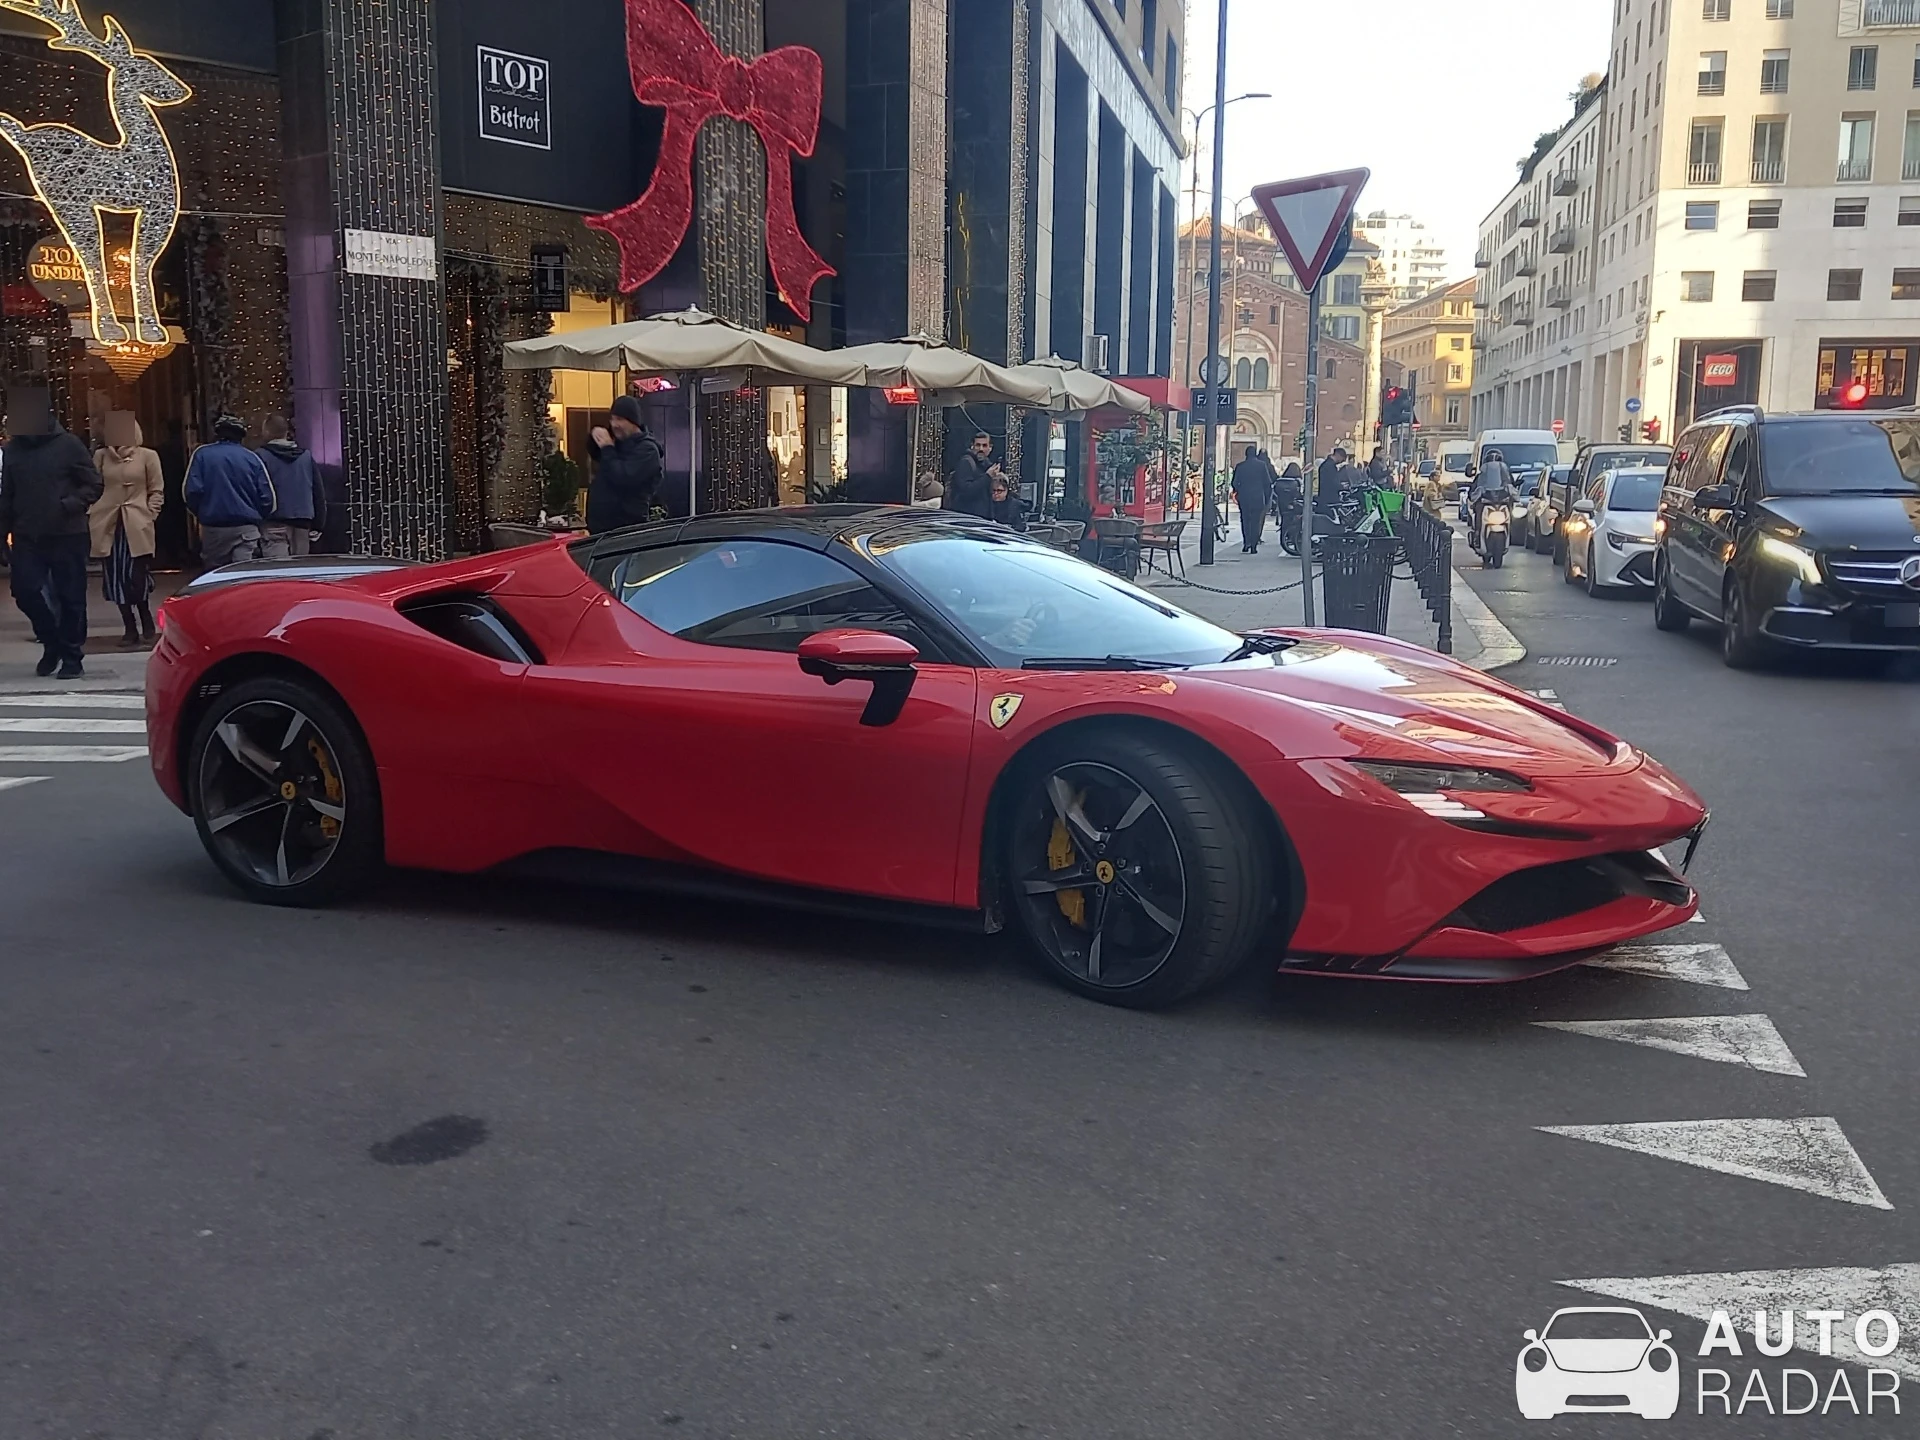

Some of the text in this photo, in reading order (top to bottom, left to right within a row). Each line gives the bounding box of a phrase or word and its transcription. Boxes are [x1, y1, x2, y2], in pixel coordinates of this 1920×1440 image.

[483, 54, 544, 93] TOP
[490, 104, 541, 133] Bistrot
[385, 237, 397, 245] VIA
[347, 251, 434, 268] MONTE NAPOLEONE
[1707, 364, 1734, 375] LEGO
[1197, 394, 1231, 405] FZI
